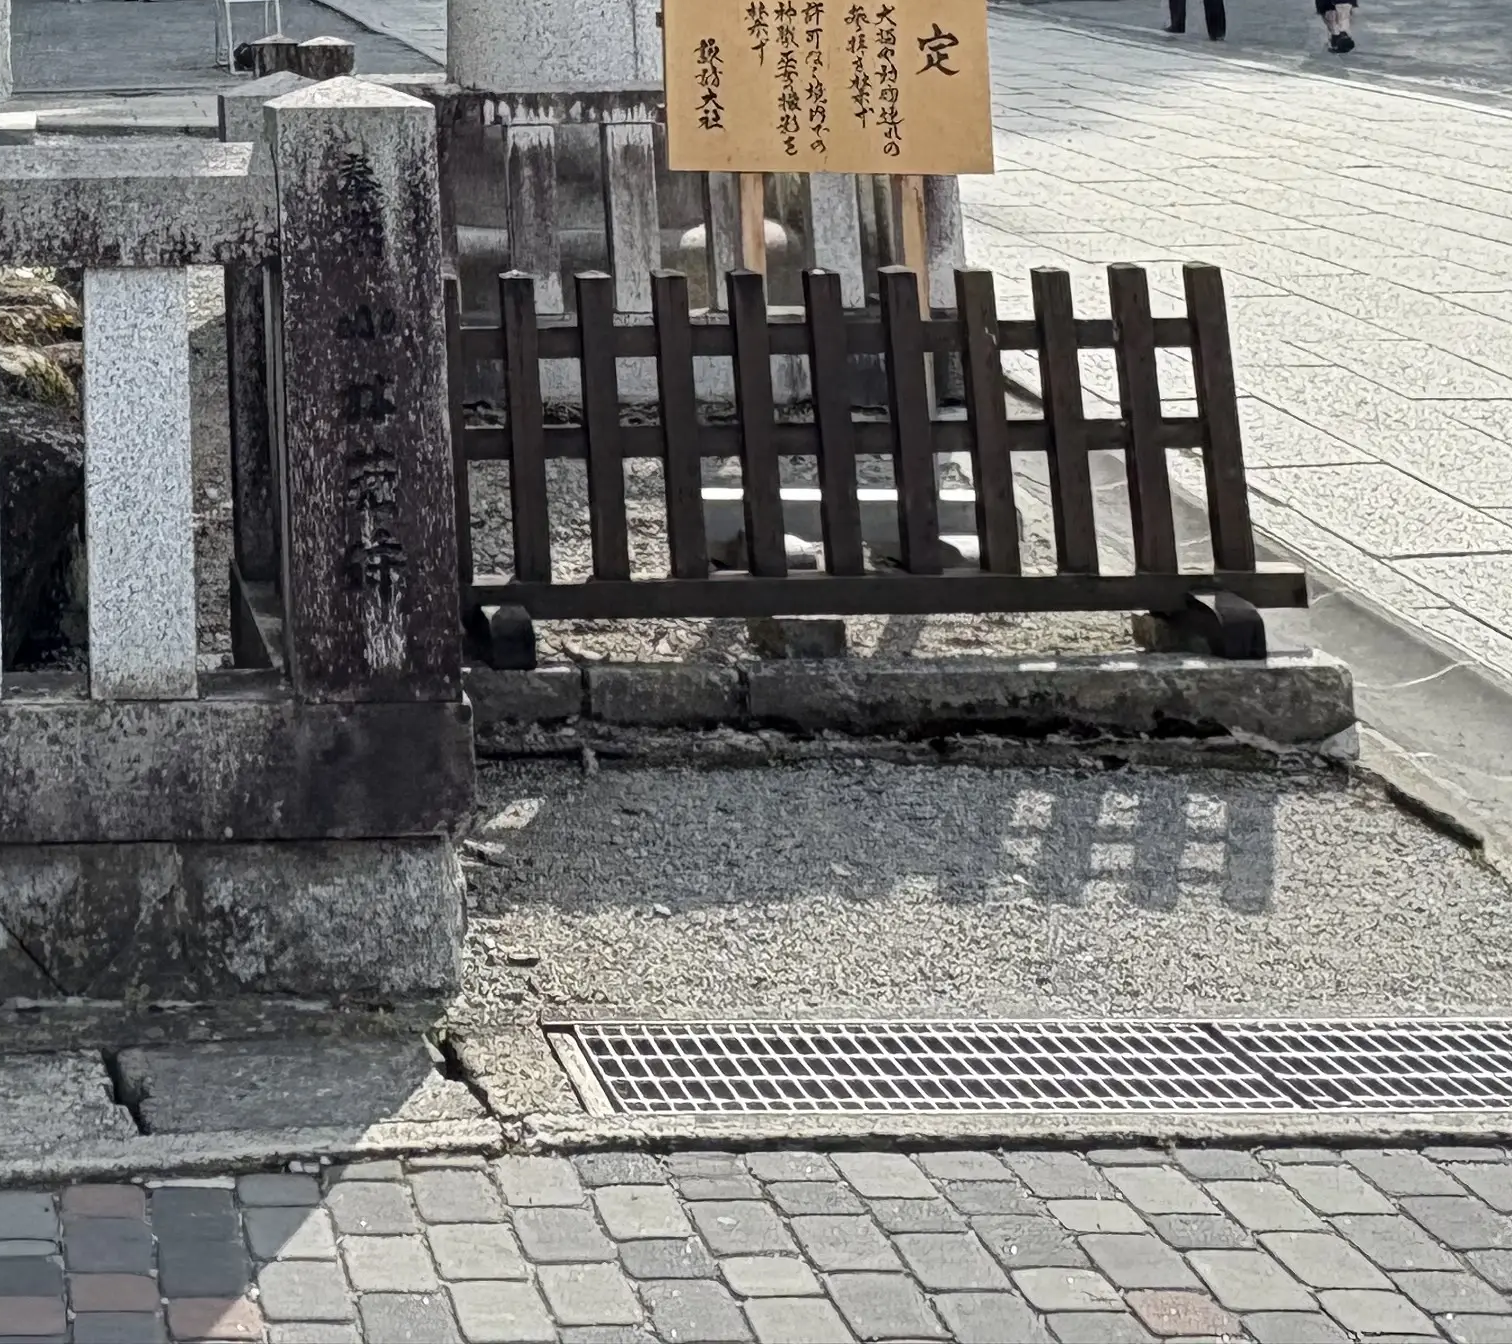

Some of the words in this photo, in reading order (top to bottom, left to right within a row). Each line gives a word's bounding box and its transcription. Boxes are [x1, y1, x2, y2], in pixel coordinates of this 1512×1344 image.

[693, 37, 727, 132] 諏訪大社
[916, 22, 960, 76] 定
